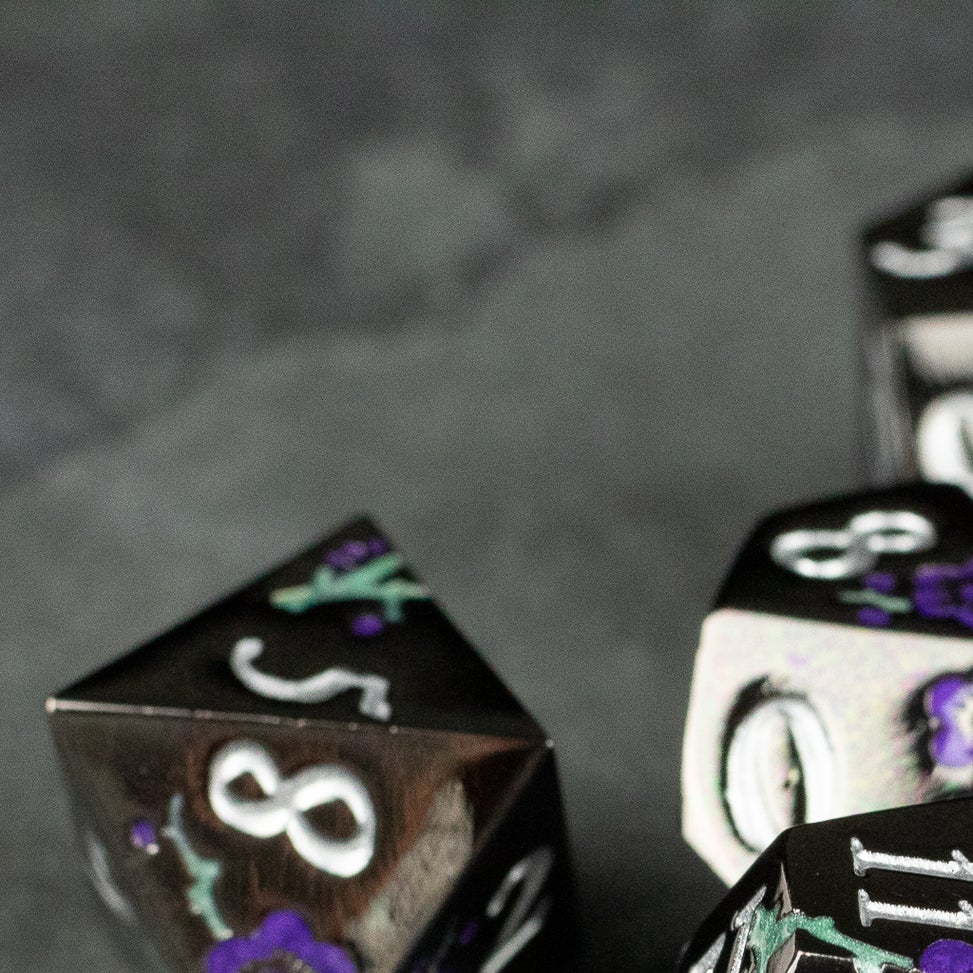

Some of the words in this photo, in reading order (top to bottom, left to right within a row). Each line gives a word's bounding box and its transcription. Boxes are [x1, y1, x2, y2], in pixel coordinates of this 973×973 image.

[769, 510, 936, 581] 8
[208, 738, 377, 878] 8
[721, 694, 838, 851] 0
